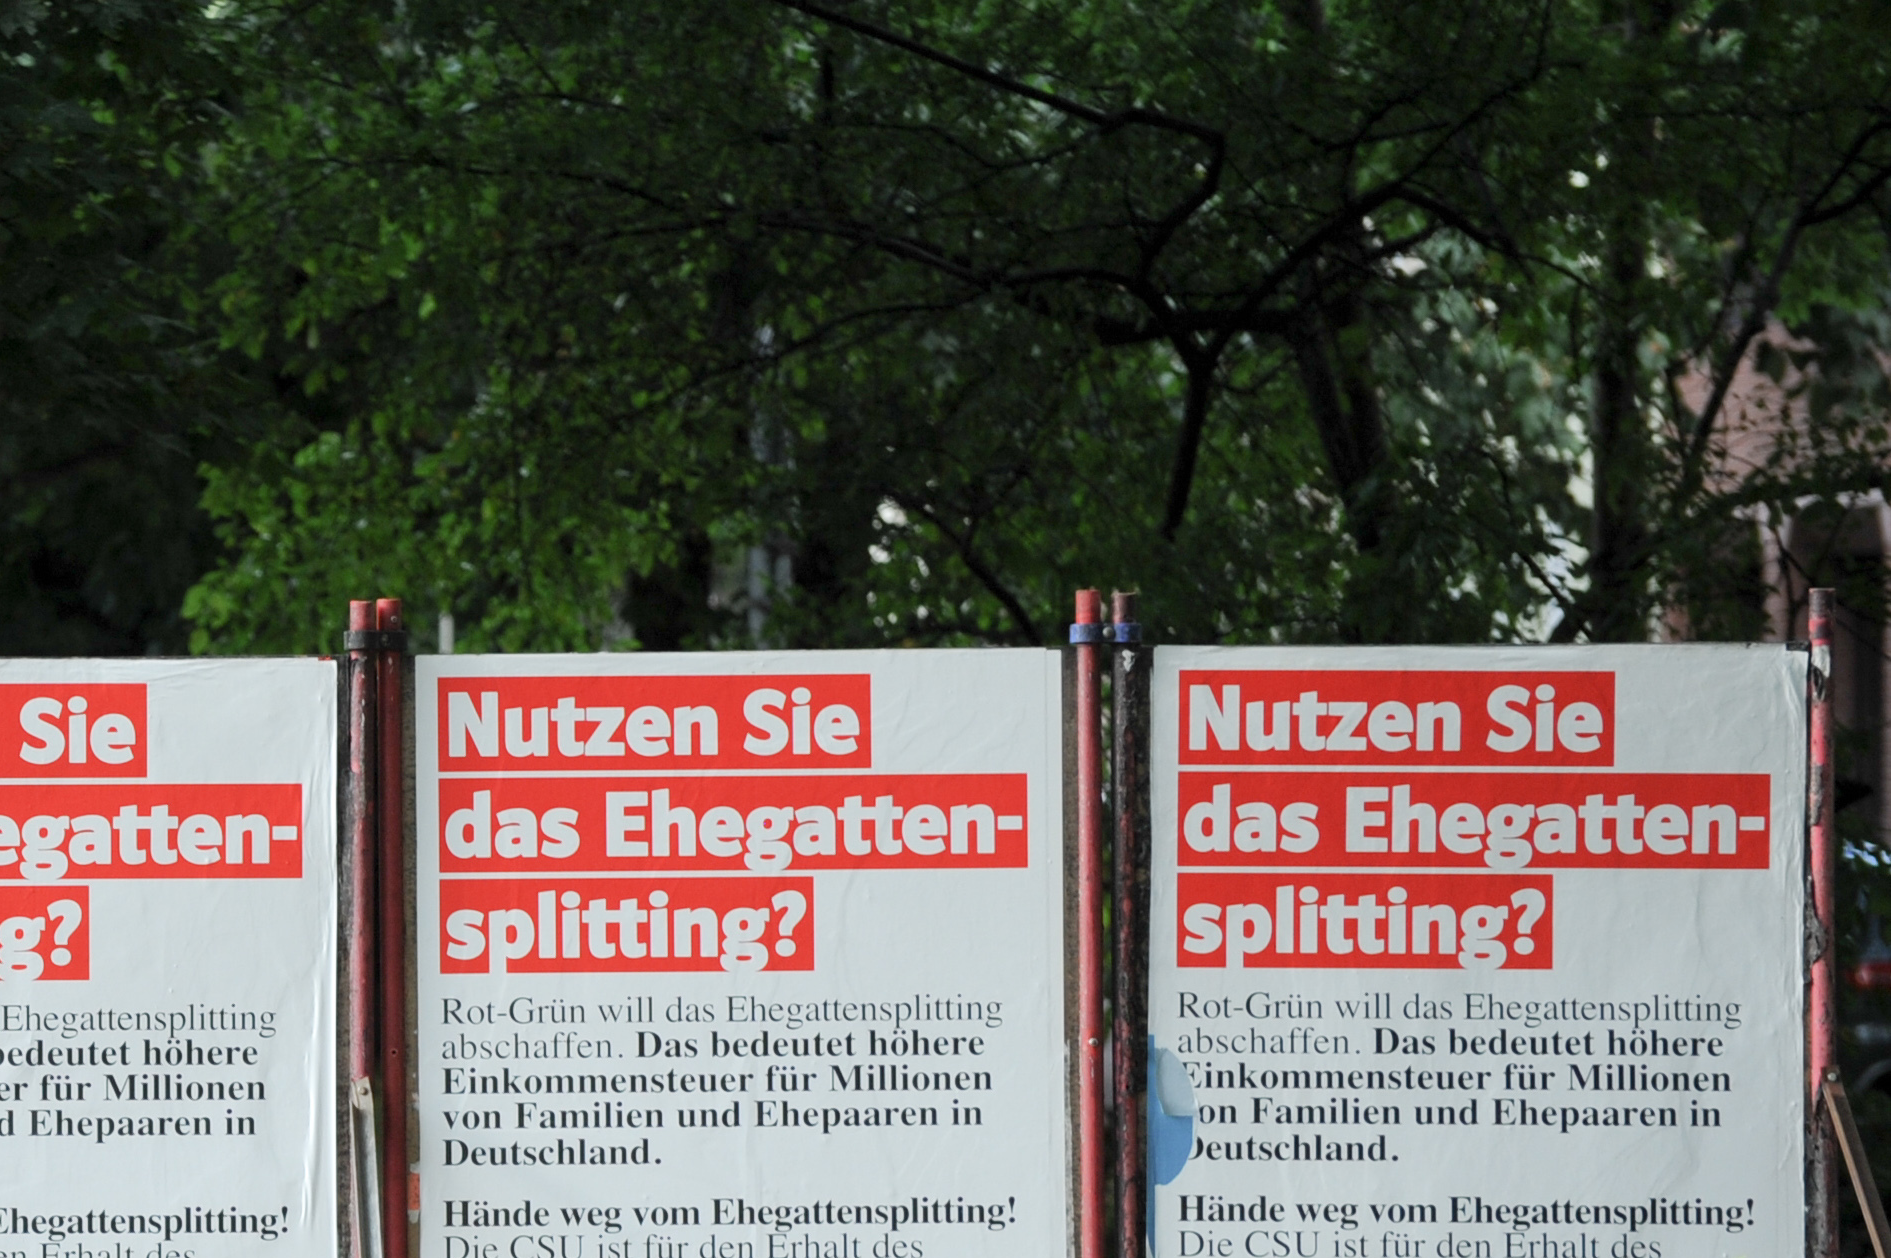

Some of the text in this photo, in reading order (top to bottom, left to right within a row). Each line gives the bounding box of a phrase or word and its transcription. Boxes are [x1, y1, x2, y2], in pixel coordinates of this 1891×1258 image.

[20, 696, 136, 764] Sie
[448, 687, 860, 758] Nutzen Sie
[1189, 683, 1604, 753] Nutzen Sie
[445, 788, 1023, 871] das Ehegatten-
[1184, 783, 1766, 868] das Ehegatten-
[446, 889, 807, 973] splitting?
[1183, 885, 1547, 970] splitting?
[441, 994, 1003, 1030] Rot-Grün will das Ehegattensplitting
[1178, 1026, 1724, 1057] abschaffen. Das bedeutet höhere
[40, 1074, 91, 1101] für
[104, 1074, 266, 1101] Millionen
[1503, 1063, 1556, 1091] für
[1567, 1063, 1732, 1092] Millionen
[443, 1099, 983, 1135] von Familien und Ehepaaren in
[441, 1138, 661, 1167] Deutschland.
[442, 1196, 1016, 1235] Hände weg vom Ehegattensplitting!
[1177, 1194, 1755, 1234] Hände weg vom Ehegattensplitting!
